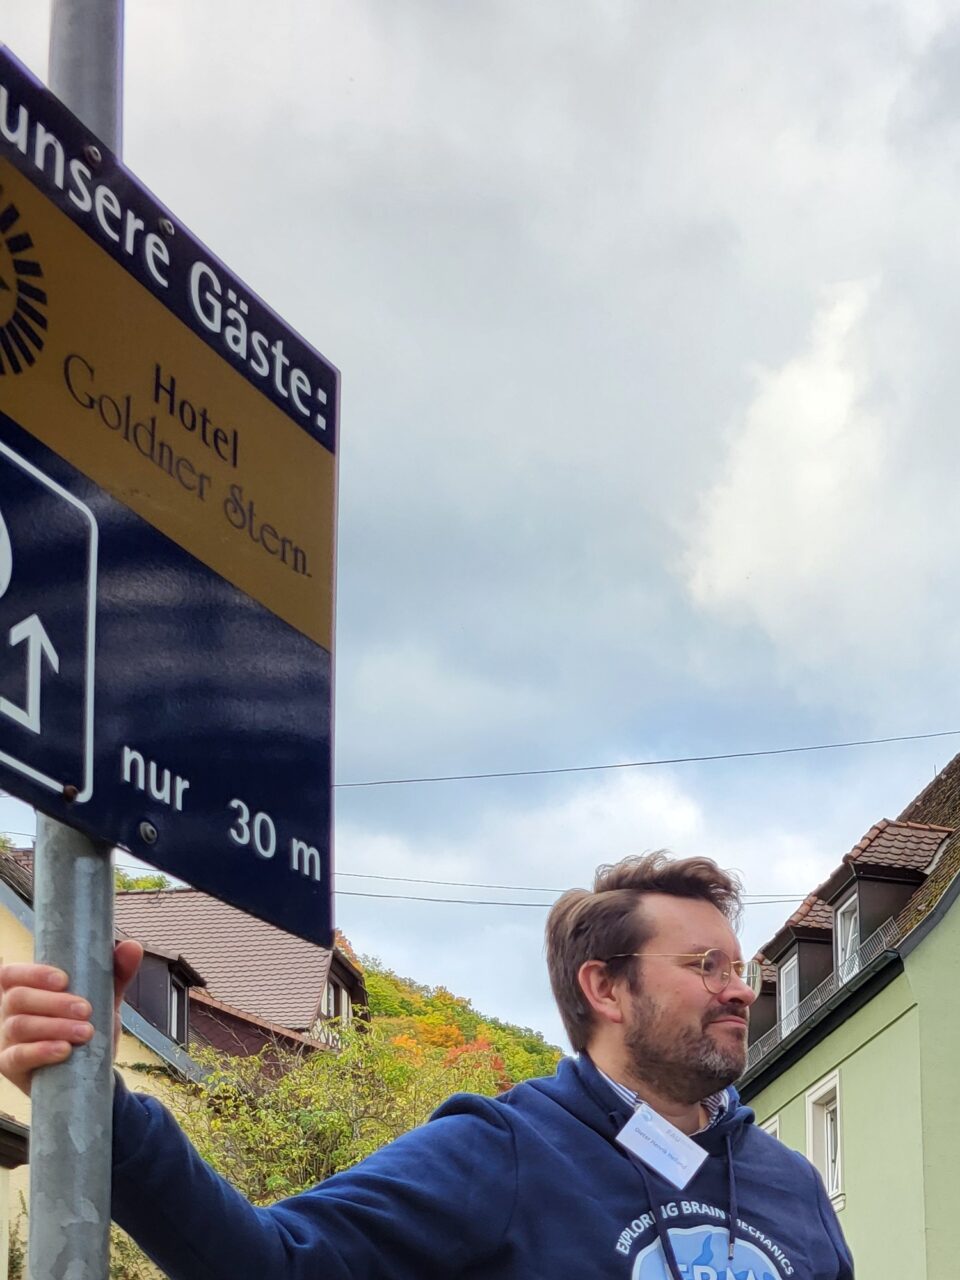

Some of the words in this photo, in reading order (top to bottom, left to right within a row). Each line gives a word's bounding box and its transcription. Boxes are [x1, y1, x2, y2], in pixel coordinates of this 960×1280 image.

[0, 83, 171, 288] unsere
[190, 261, 327, 431] Gäste:
[63, 354, 212, 500] Goldner
[153, 363, 239, 468] Hotel
[122, 745, 190, 811] nur
[229, 798, 277, 858] 30
[292, 838, 321, 881] m
[680, 1200, 726, 1220] BRAIN
